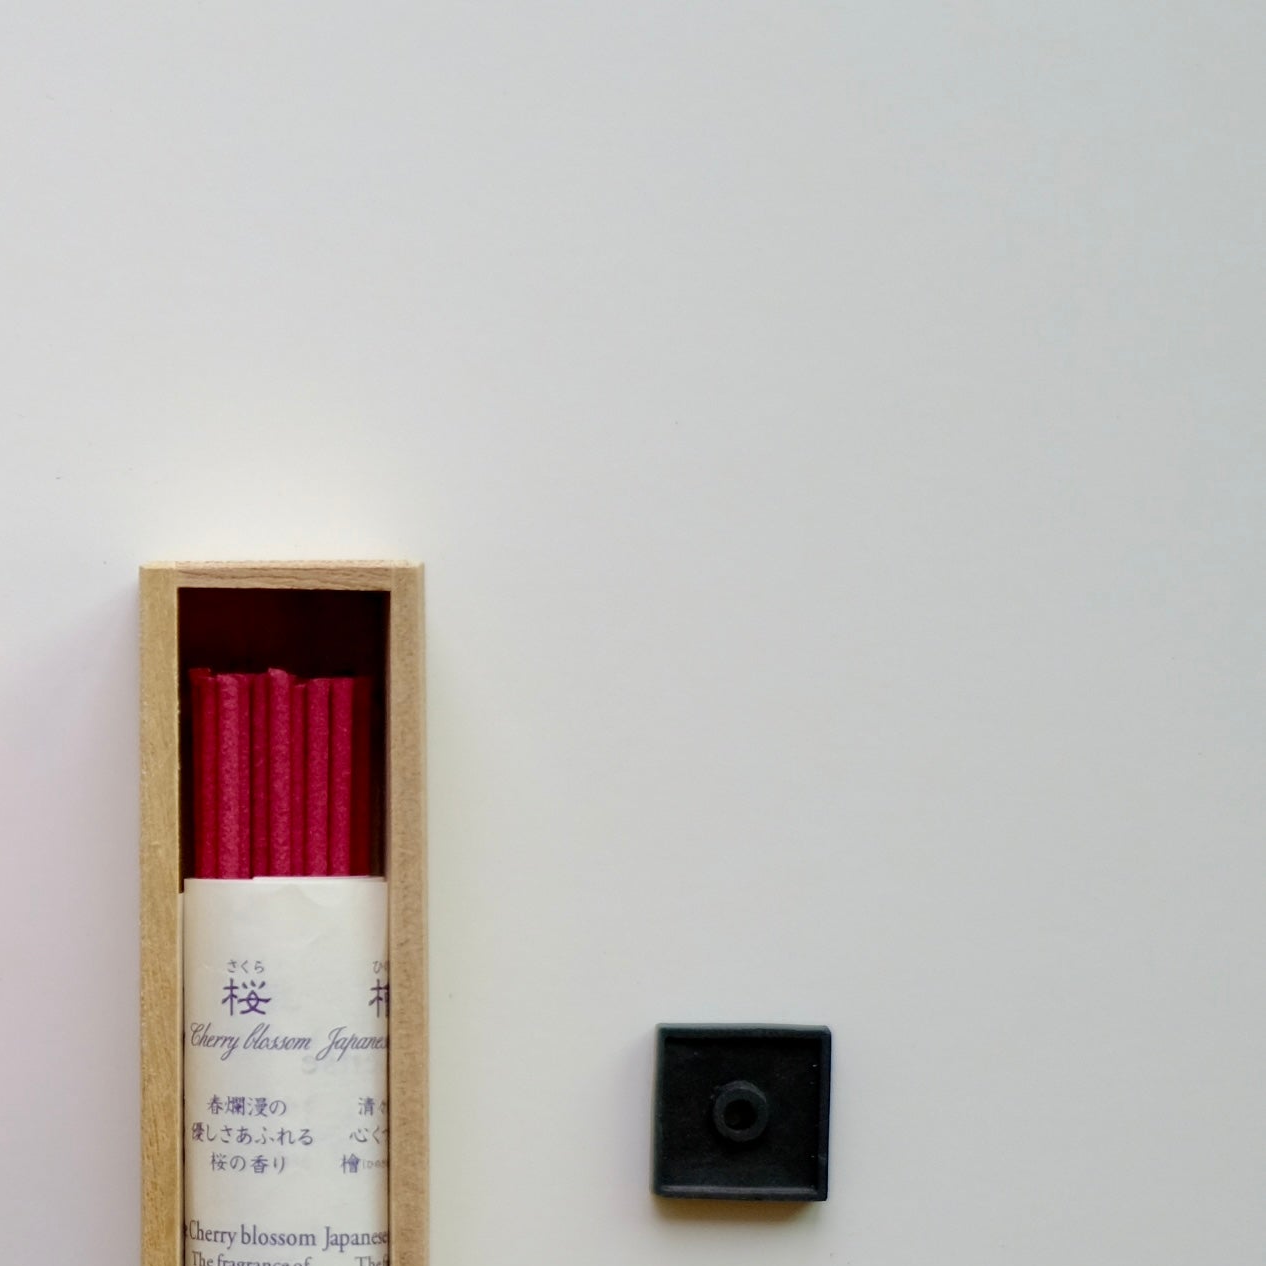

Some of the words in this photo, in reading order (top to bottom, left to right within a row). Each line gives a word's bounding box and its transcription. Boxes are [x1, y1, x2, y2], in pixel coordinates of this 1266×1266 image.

[227, 960, 264, 973] さくら
[221, 978, 272, 1016] 桜
[190, 1023, 240, 1061] Cherry
[243, 1022, 311, 1050] blossom
[207, 1095, 287, 1116] 春爛漫の
[191, 1122, 314, 1145] 優しさあふれる
[211, 1152, 286, 1174] 桜の香り
[189, 1219, 236, 1249] Cherry
[241, 1224, 316, 1246] blossom
